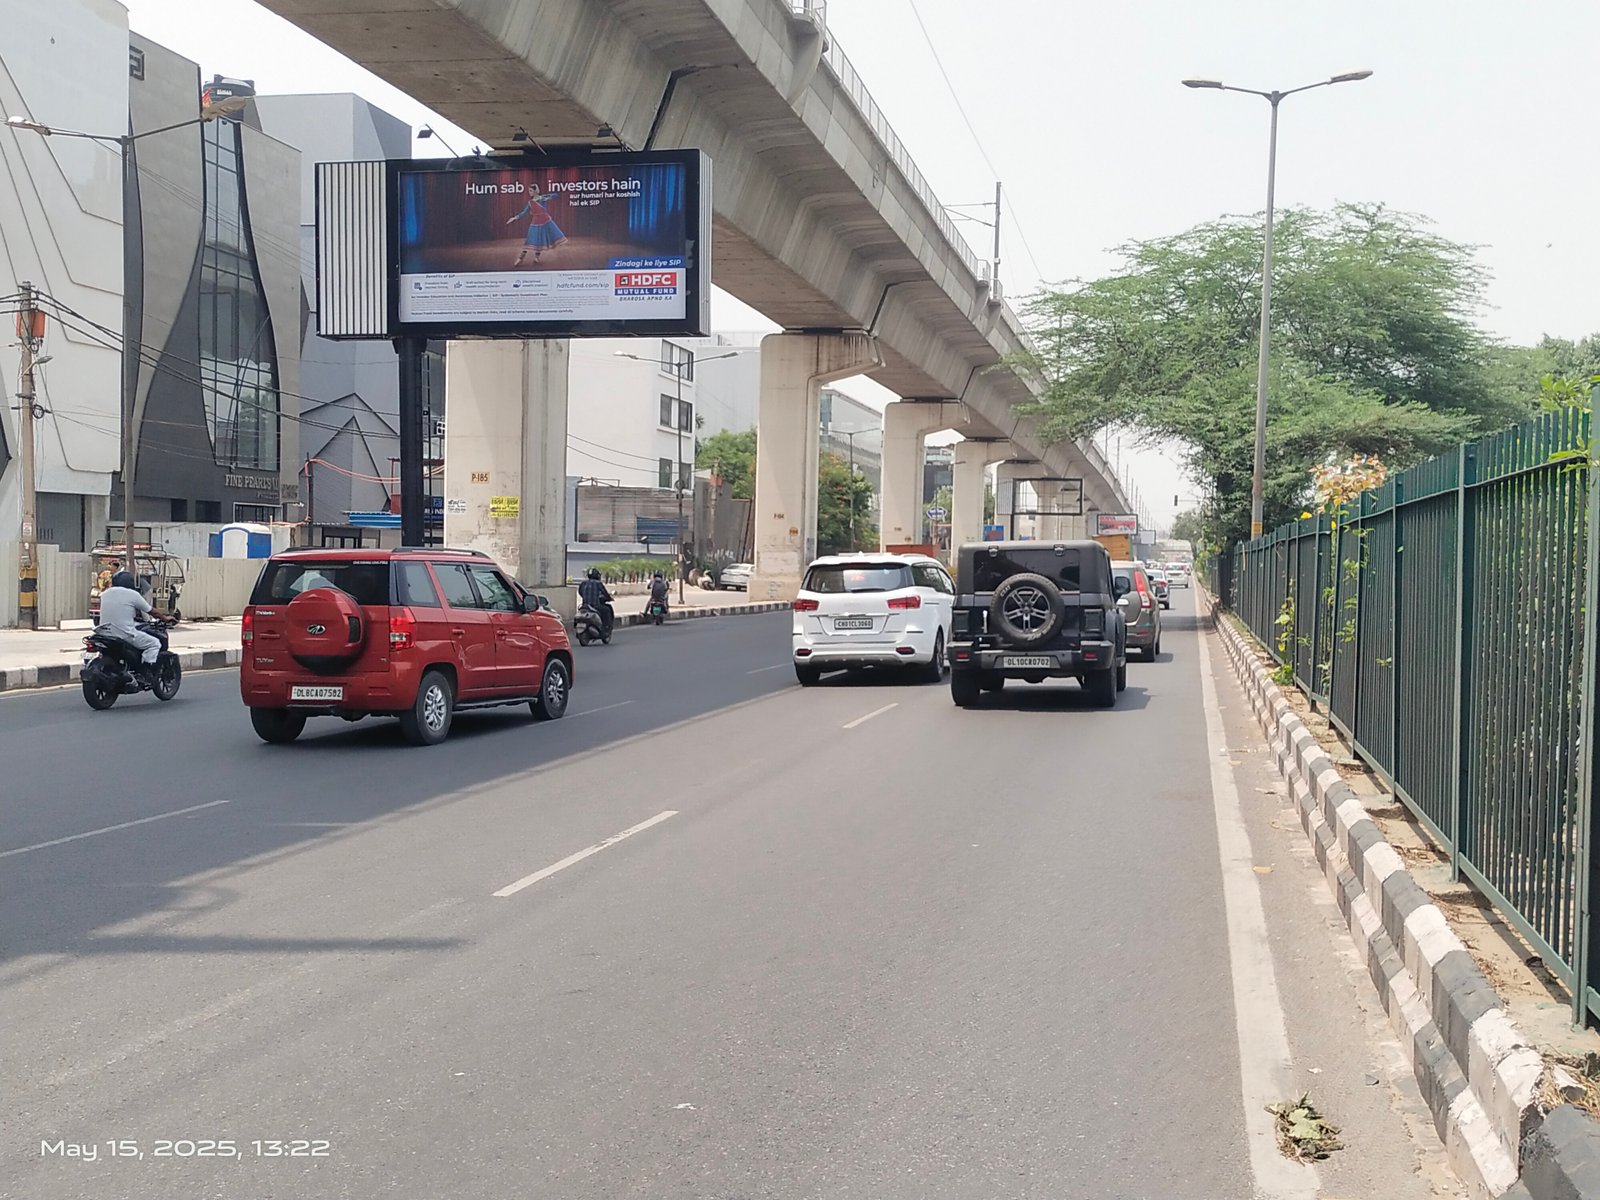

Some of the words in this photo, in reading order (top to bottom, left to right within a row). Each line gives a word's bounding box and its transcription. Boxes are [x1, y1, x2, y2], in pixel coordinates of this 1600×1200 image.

[465, 182, 497, 195] Hum
[500, 180, 524, 194] sab
[548, 179, 608, 192] investors
[611, 177, 641, 190] hain
[616, 190, 641, 198] koshish
[615, 260, 643, 268] Zindagi
[654, 259, 668, 268] liye
[631, 274, 671, 286] HDFC
[225, 474, 243, 488] FINE
[244, 475, 272, 490] PEARLS
[471, 473, 489, 482] P-185
[1007, 657, 1049, 666] DL10CR0702
